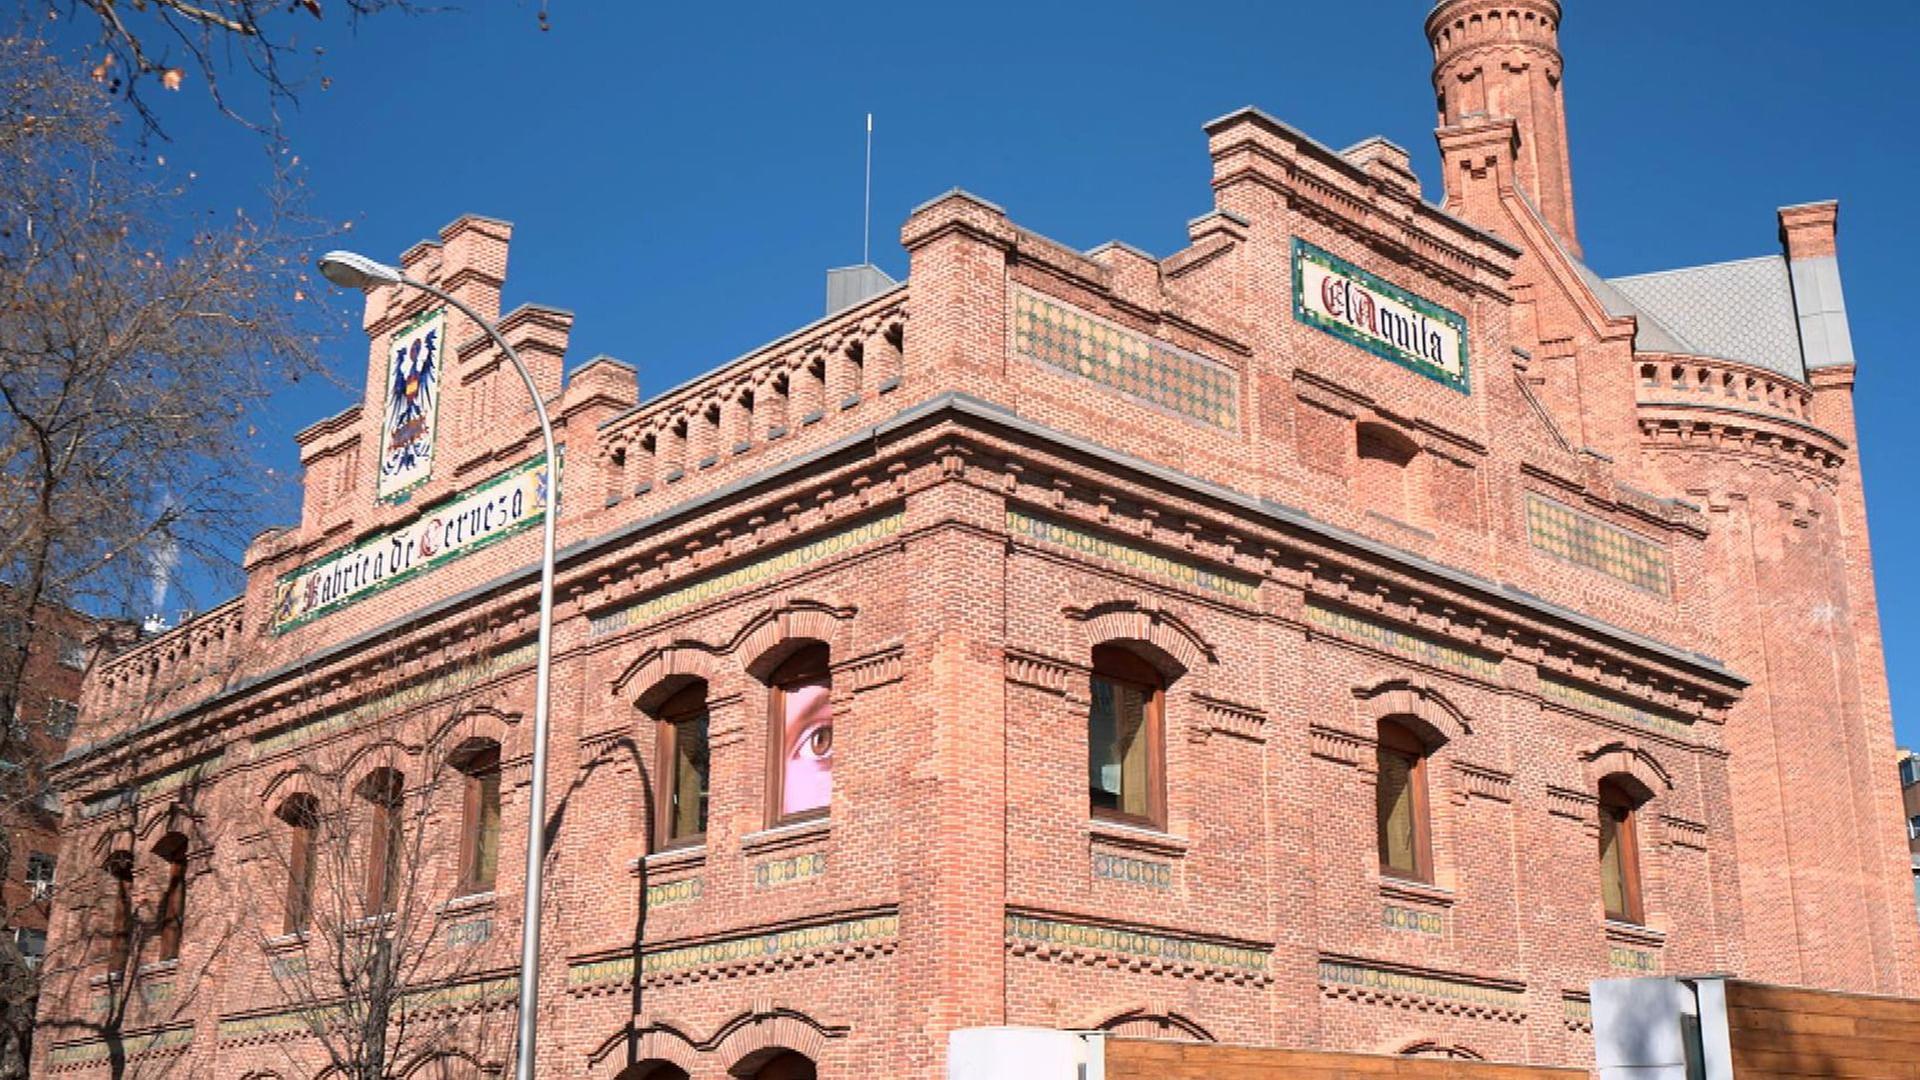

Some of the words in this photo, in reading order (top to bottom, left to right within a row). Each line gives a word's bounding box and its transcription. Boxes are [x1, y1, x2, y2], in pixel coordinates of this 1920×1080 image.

[1321, 275, 1354, 325] El
[390, 532, 414, 574] de
[419, 488, 522, 558] Cerveza
